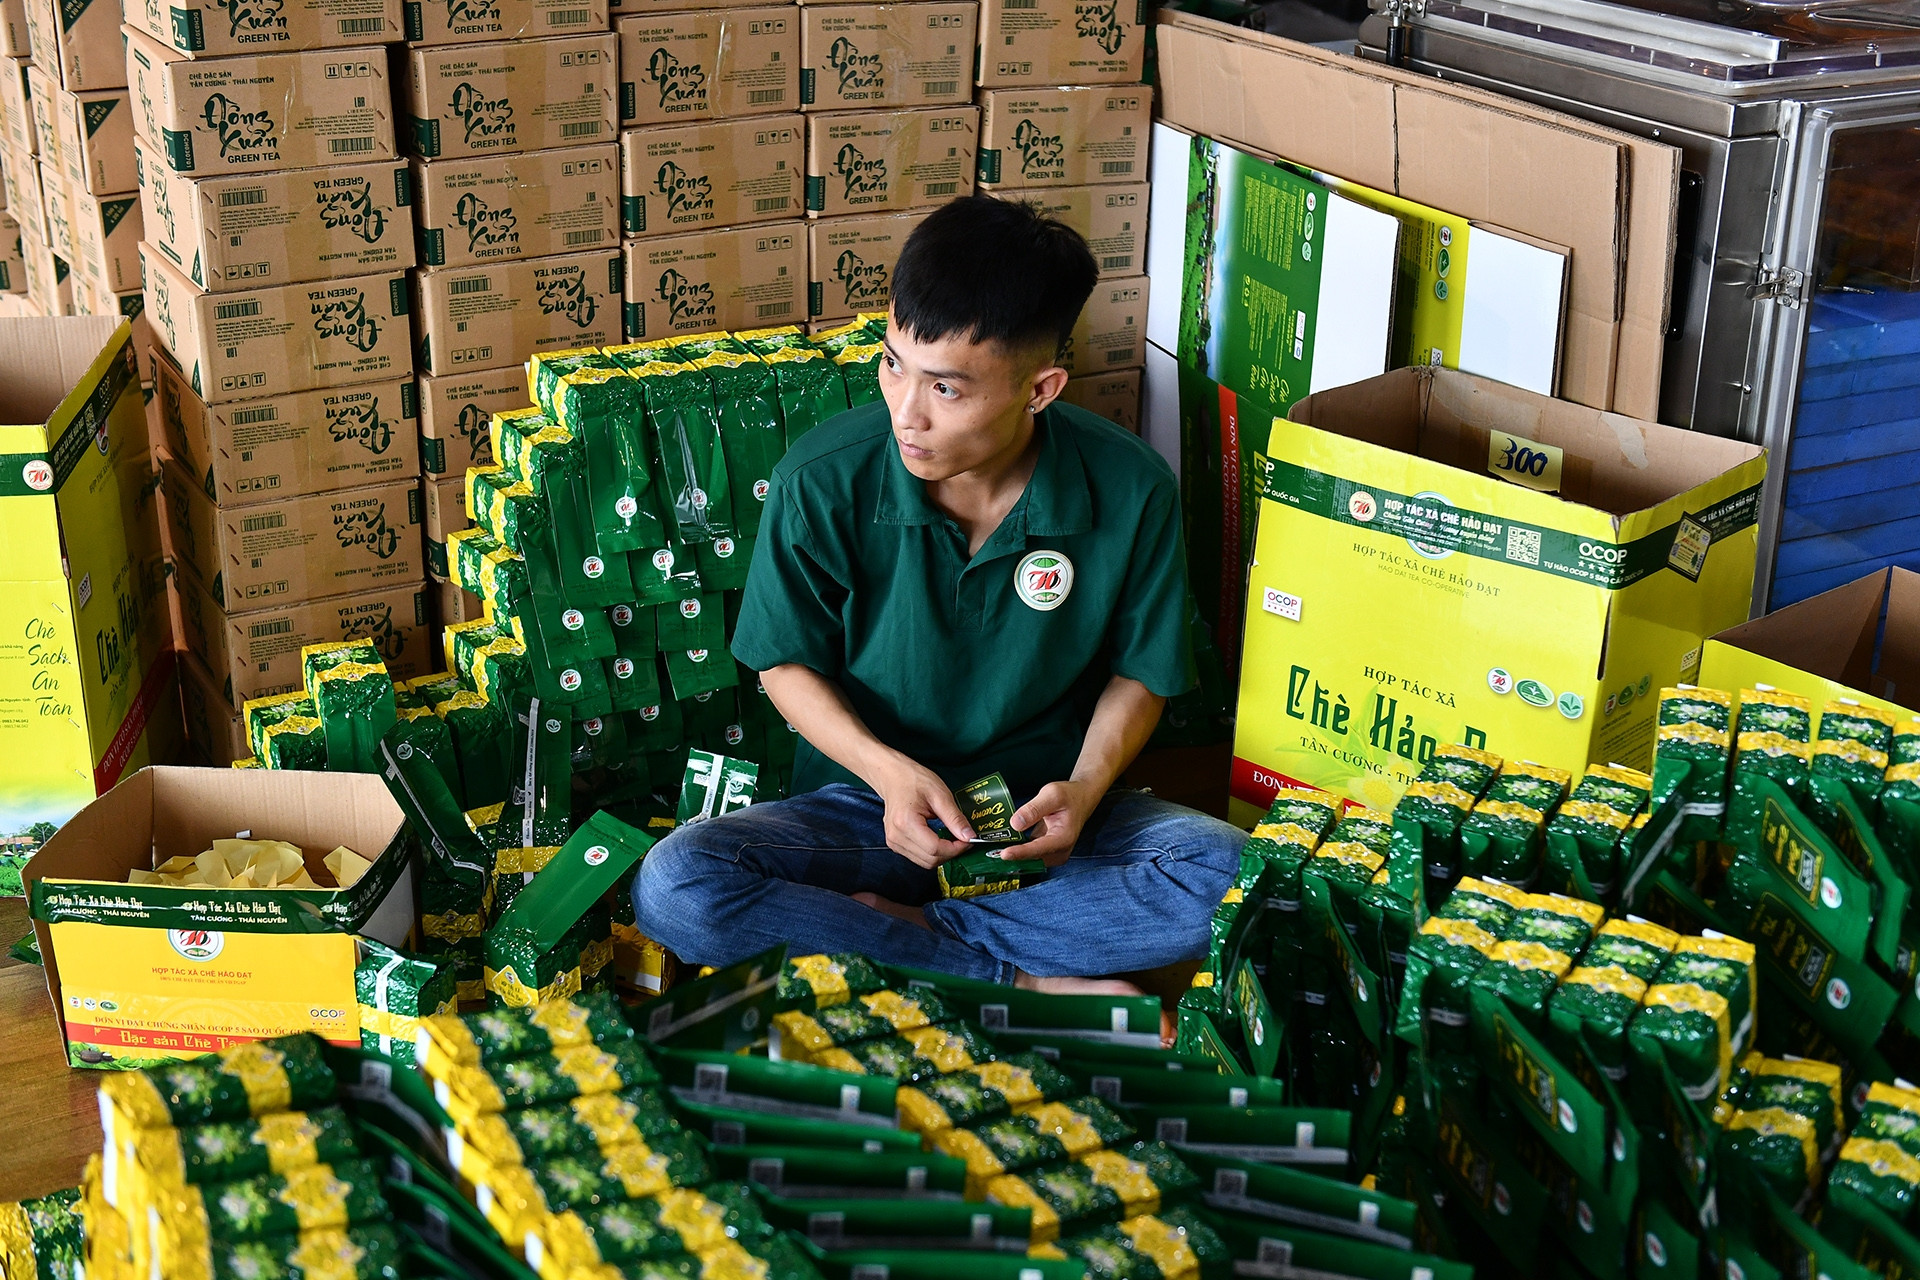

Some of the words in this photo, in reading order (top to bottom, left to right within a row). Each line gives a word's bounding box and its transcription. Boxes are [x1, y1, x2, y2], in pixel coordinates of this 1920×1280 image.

[454, 25, 483, 34] GREEN
[486, 23, 502, 32] TEA
[238, 33, 269, 43] GREEN
[272, 32, 290, 41] TEA
[843, 92, 869, 100] GREEN
[665, 104, 691, 113] GREEN
[693, 102, 708, 111] TEA
[471, 139, 499, 149] GREEN
[501, 137, 517, 146] TEA
[228, 154, 260, 163] GREEN
[262, 152, 280, 160] TEA
[312, 180, 330, 189] TEA
[332, 176, 363, 186] GREEN
[849, 196, 873, 204] GREEN
[673, 214, 698, 224] GREEN
[700, 212, 715, 220] TEA
[475, 248, 503, 258] GREEN
[505, 246, 521, 254] TEA
[533, 269, 549, 277] TEA
[551, 265, 579, 275] GREEN
[308, 292, 325, 301] TEA
[327, 287, 357, 298] GREEN
[675, 320, 701, 330] GREEN
[702, 318, 717, 326] TEA
[322, 396, 339, 405] TEA
[341, 392, 371, 402] GREEN
[1495, 438, 1548, 477] 300
[349, 498, 378, 509] GREEN
[1271, 491, 1288, 500] QUỐC
[1289, 495, 1300, 504] GIA
[330, 503, 347, 512] TEA
[1384, 499, 1404, 512] HỢP
[1406, 504, 1424, 516] TÁC
[1440, 512, 1459, 525] CHÈ
[1461, 516, 1481, 530] HẢO
[1483, 522, 1502, 536] ĐẠT
[1579, 542, 1627, 563] OCOP
[1353, 543, 1376, 556] HỢP
[1380, 551, 1401, 565] TÁC
[1404, 559, 1418, 571] XÃ
[1422, 565, 1445, 580] CHÈ
[1449, 573, 1473, 588] HẢO
[1476, 583, 1500, 596] ĐẠT
[1569, 568, 1589, 577] OCOP
[1595, 575, 1609, 583] SAO
[1409, 572, 1420, 581] TEA
[1421, 578, 1470, 599] CO-OPERATIVE
[1268, 591, 1297, 608] OCOP
[25, 618, 56, 639] Chè
[32, 671, 59, 690] An
[1363, 665, 1396, 686] HỢP
[1401, 678, 1432, 699] TÁC
[1435, 690, 1456, 708] XÃ
[35, 696, 72, 716] Toàn
[1285, 664, 1350, 736] Chè
[1369, 693, 1437, 766] Hảo
[1300, 736, 1328, 756] TÂN
[1332, 746, 1384, 779] CƯƠNG
[1253, 770, 1284, 790] ĐƠN
[59, 894, 72, 907] Hợp
[120, 910, 149, 918] NGUYÊN
[193, 901, 207, 914] Hợp
[209, 901, 222, 912] Tác
[225, 902, 235, 912] Xã
[236, 902, 250, 913] Chè
[252, 902, 266, 913] Hảo
[268, 902, 281, 915] Đạt
[188, 968, 198, 976] XÃ
[200, 969, 216, 977] CHÈ
[218, 970, 235, 978] HẢO
[236, 972, 252, 980] ĐẠT
[310, 1009, 345, 1018] OCOP
[95, 1016, 113, 1024] ĐƠN
[147, 1020, 178, 1029] CHỨNG
[262, 1026, 288, 1035] QUỐC
[119, 1030, 148, 1045] Đặc
[153, 1036, 178, 1046] sản
[183, 1035, 212, 1048] Chè
